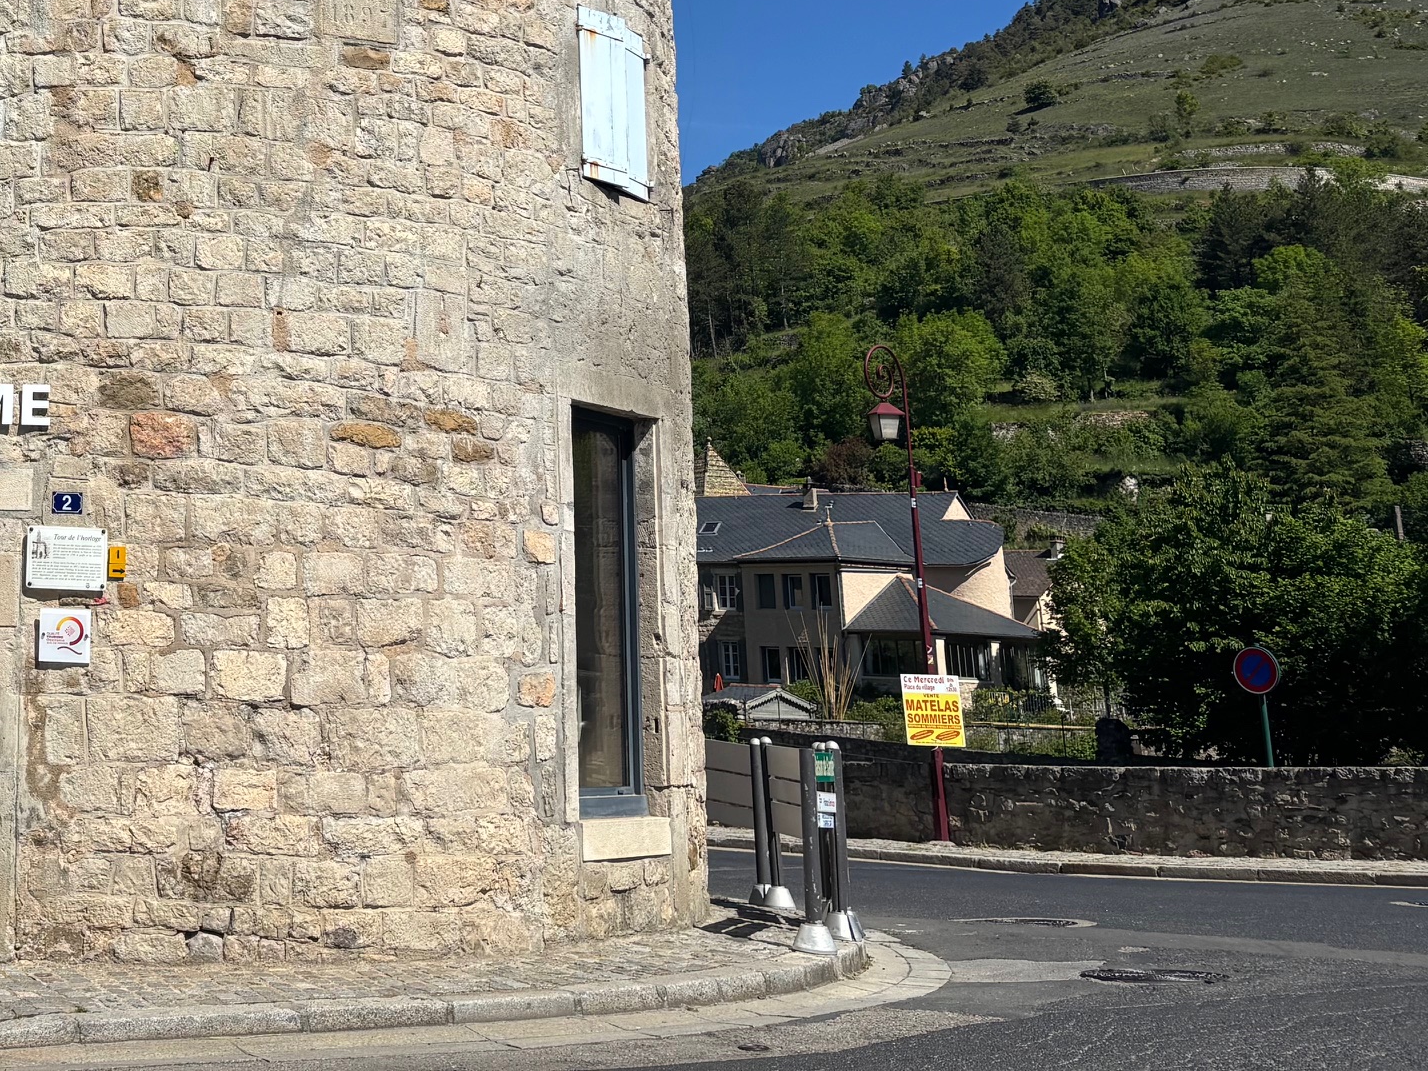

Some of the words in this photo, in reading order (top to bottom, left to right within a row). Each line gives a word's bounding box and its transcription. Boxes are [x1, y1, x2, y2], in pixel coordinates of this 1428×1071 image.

[61, 495, 72, 510] 2
[914, 676, 945, 684] Mercredi
[905, 699, 959, 713] MATELAS
[907, 713, 961, 725] SOMMIERS
